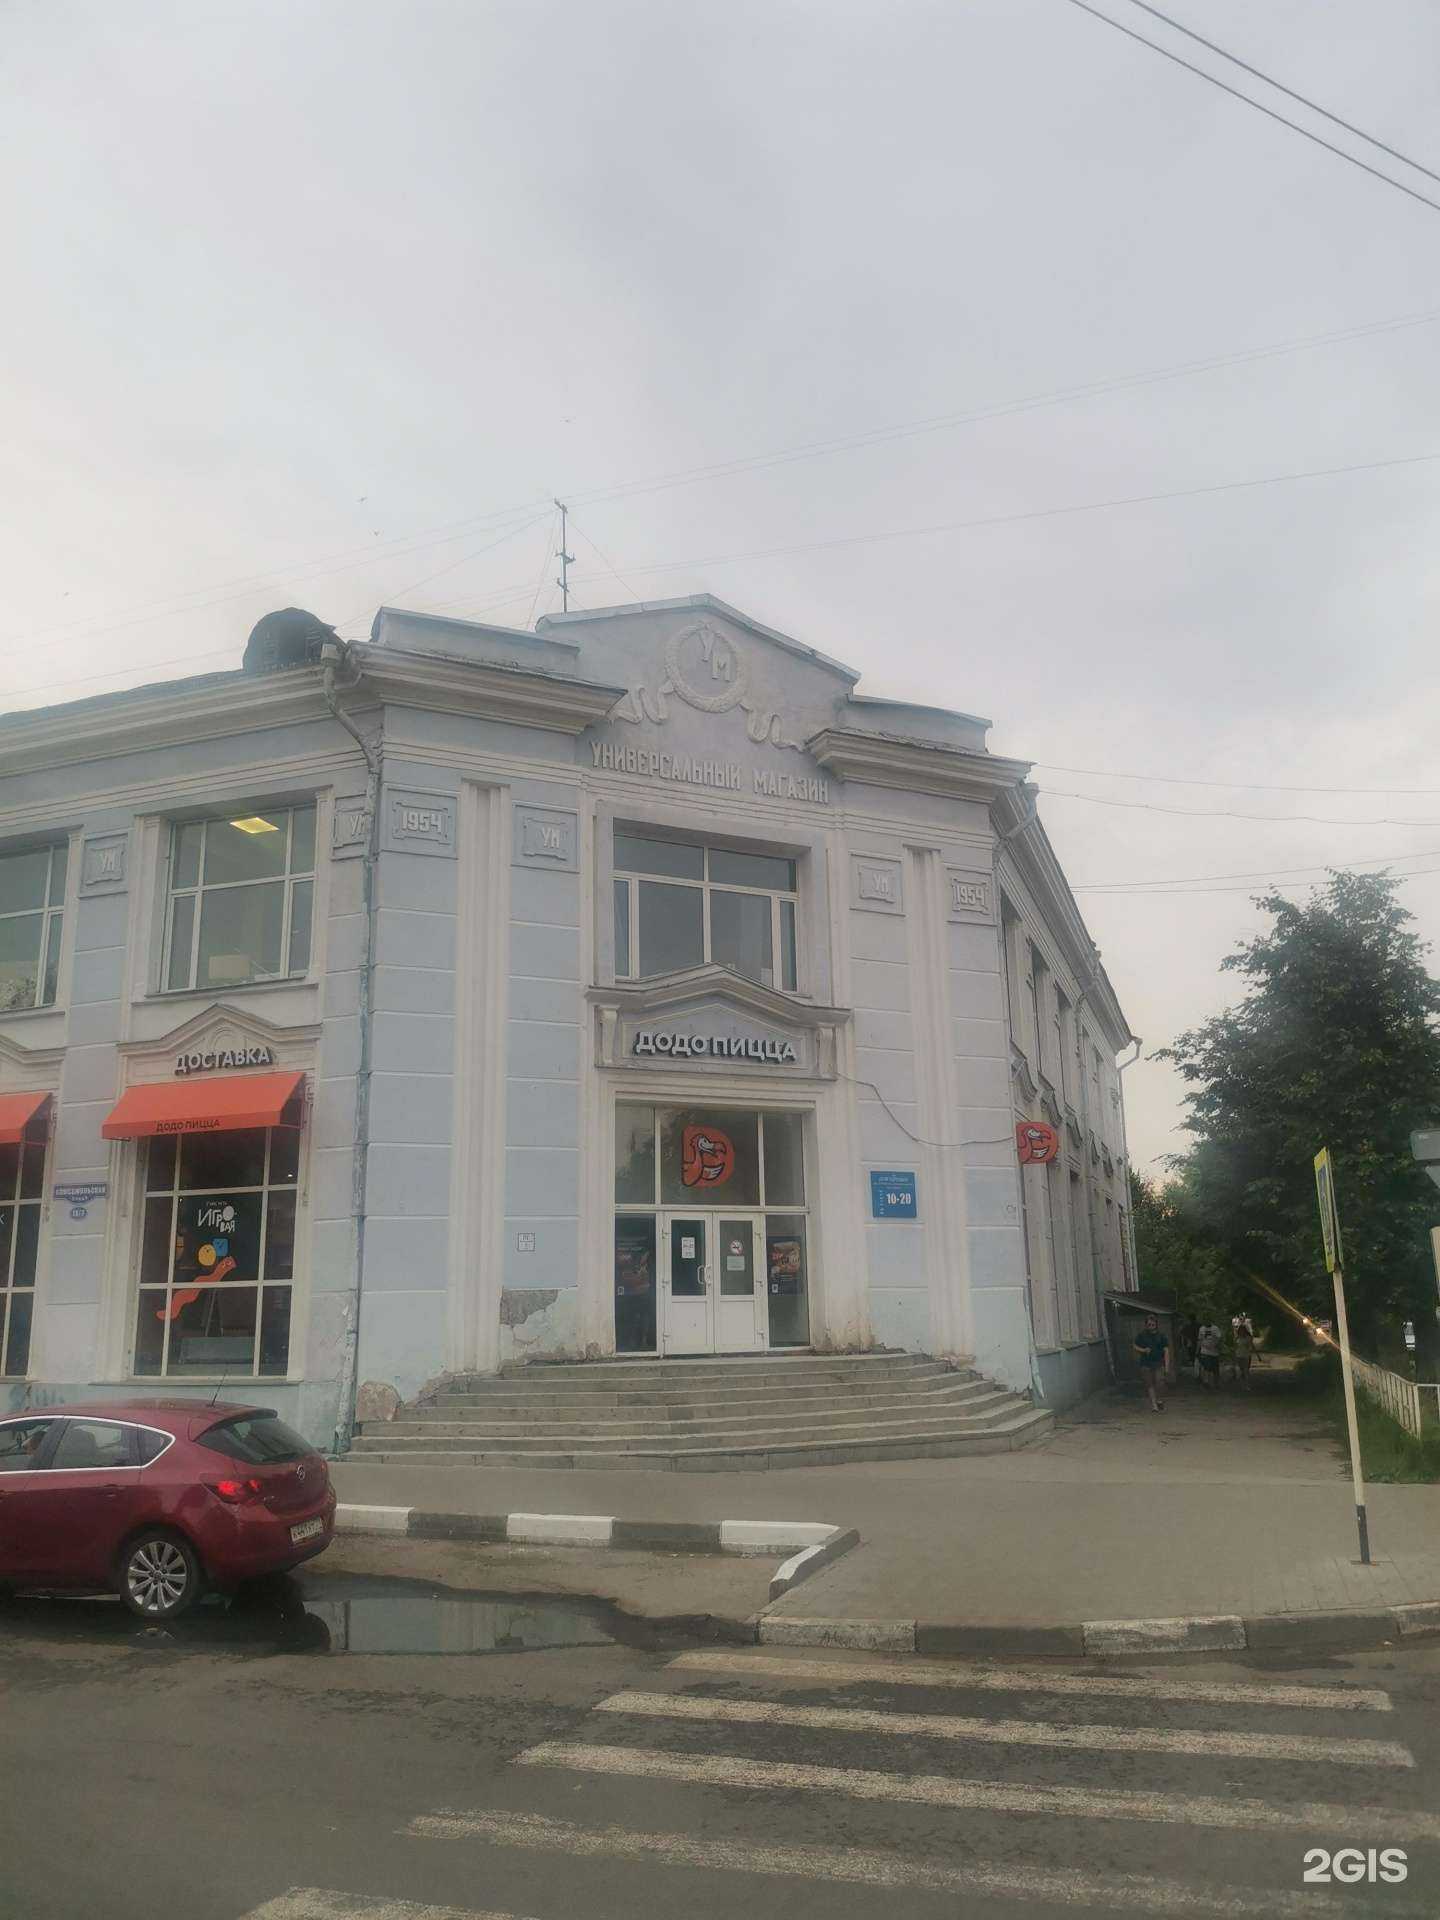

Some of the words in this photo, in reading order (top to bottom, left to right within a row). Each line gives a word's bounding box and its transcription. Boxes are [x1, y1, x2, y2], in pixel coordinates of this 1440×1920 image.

[591, 742, 742, 790] УНИВЕРСАЛЬНЫЙ
[754, 770, 829, 804] МАГАЗИН
[402, 810, 442, 833] 1954
[952, 883, 986, 907] 1954
[175, 1047, 271, 1074] ДОСТАВКА
[713, 1036, 796, 1062] ПИЦЦА
